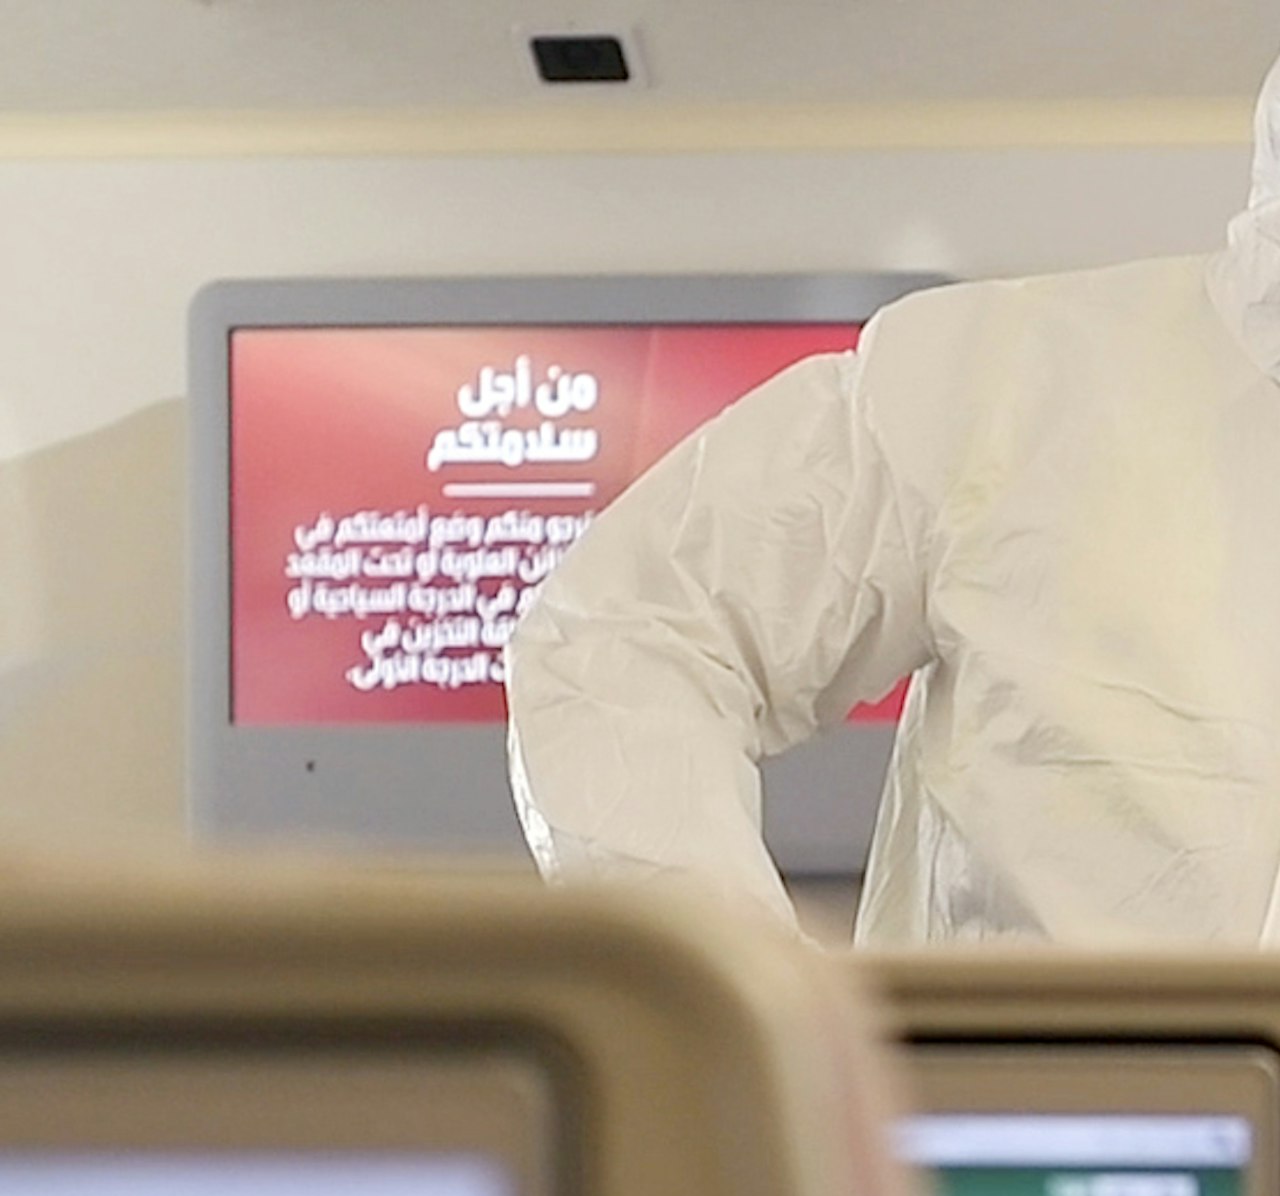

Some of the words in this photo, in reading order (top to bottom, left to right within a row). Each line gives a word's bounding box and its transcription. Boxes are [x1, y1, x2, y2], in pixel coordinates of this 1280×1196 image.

[535, 364, 598, 419] من
[426, 420, 598, 472] سلامتكم
[294, 511, 335, 550] في
